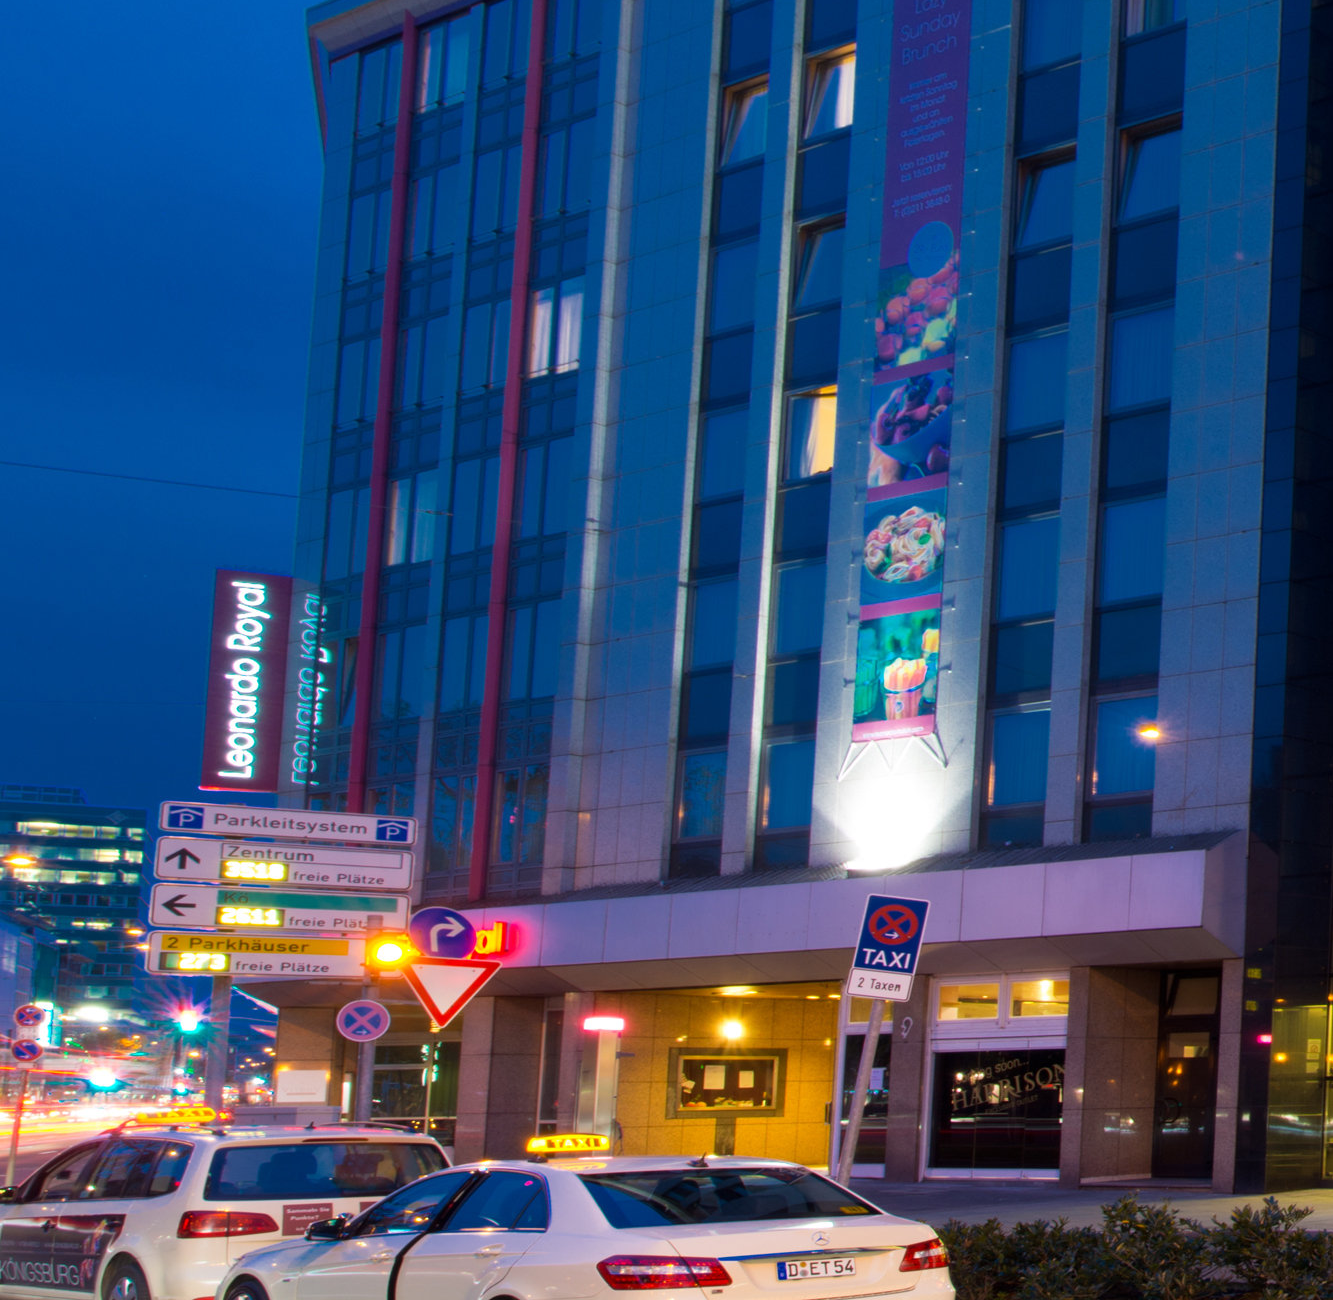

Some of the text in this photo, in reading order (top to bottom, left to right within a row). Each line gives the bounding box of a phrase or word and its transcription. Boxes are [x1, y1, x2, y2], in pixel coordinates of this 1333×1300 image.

[900, 11, 961, 42] Sunday
[902, 35, 957, 66] Brunch
[217, 581, 273, 779] Leonardo Royal
[214, 813, 367, 835] Parkleitsystem
[228, 846, 315, 862] Zentrum
[223, 861, 385, 885] 3518 freie Plätze
[224, 892, 249, 905] Kö
[220, 907, 368, 929] 2611 freie Plät
[167, 936, 310, 953] 2 Parkhäuser
[178, 953, 329, 973] 273 freie Plätze
[862, 948, 912, 970] TAXI
[857, 977, 902, 992] 2 Taxen
[551, 1137, 597, 1149] TAXI
[287, 1206, 319, 1214] Sammeln
[788, 1262, 799, 1278] D
